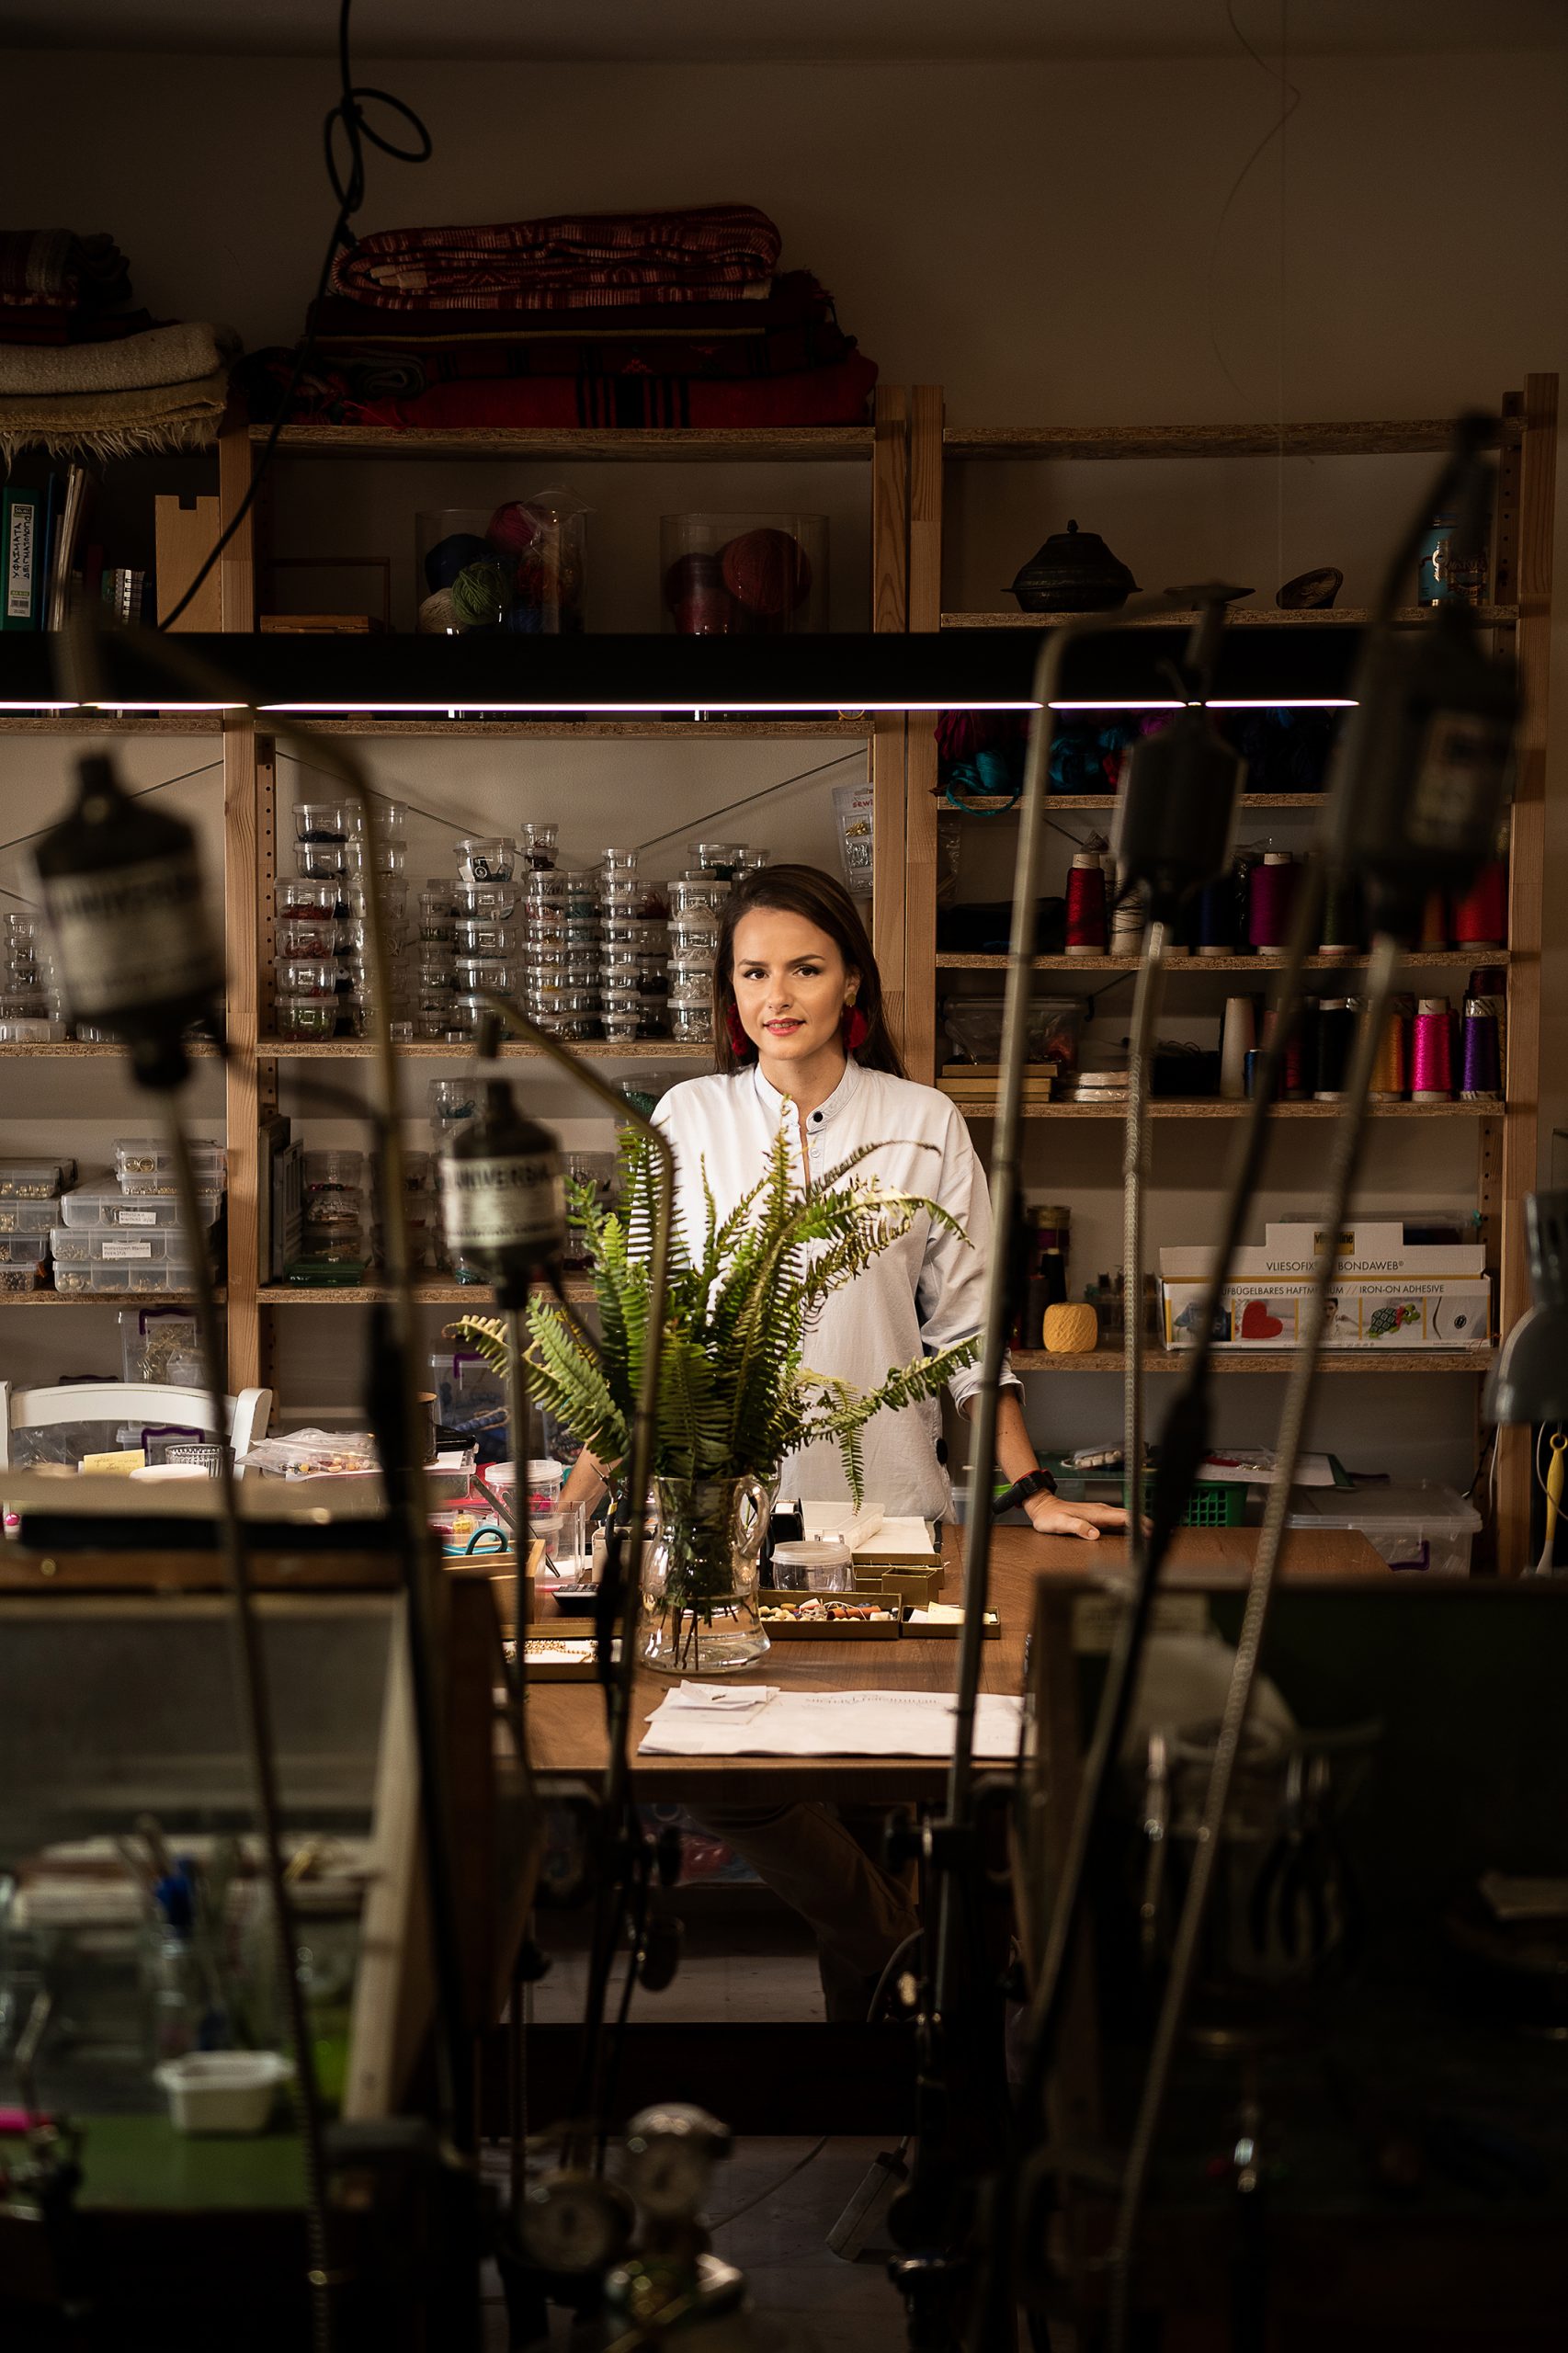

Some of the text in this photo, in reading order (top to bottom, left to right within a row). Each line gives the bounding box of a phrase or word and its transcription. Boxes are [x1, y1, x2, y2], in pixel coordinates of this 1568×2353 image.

[1220, 1286, 1284, 1295] UFBÜGELBARES
[1287, 1286, 1344, 1295] HAFTMIUM
[1360, 1285, 1401, 1294] IRON-ON
[1403, 1284, 1445, 1293] ADHESIVE
